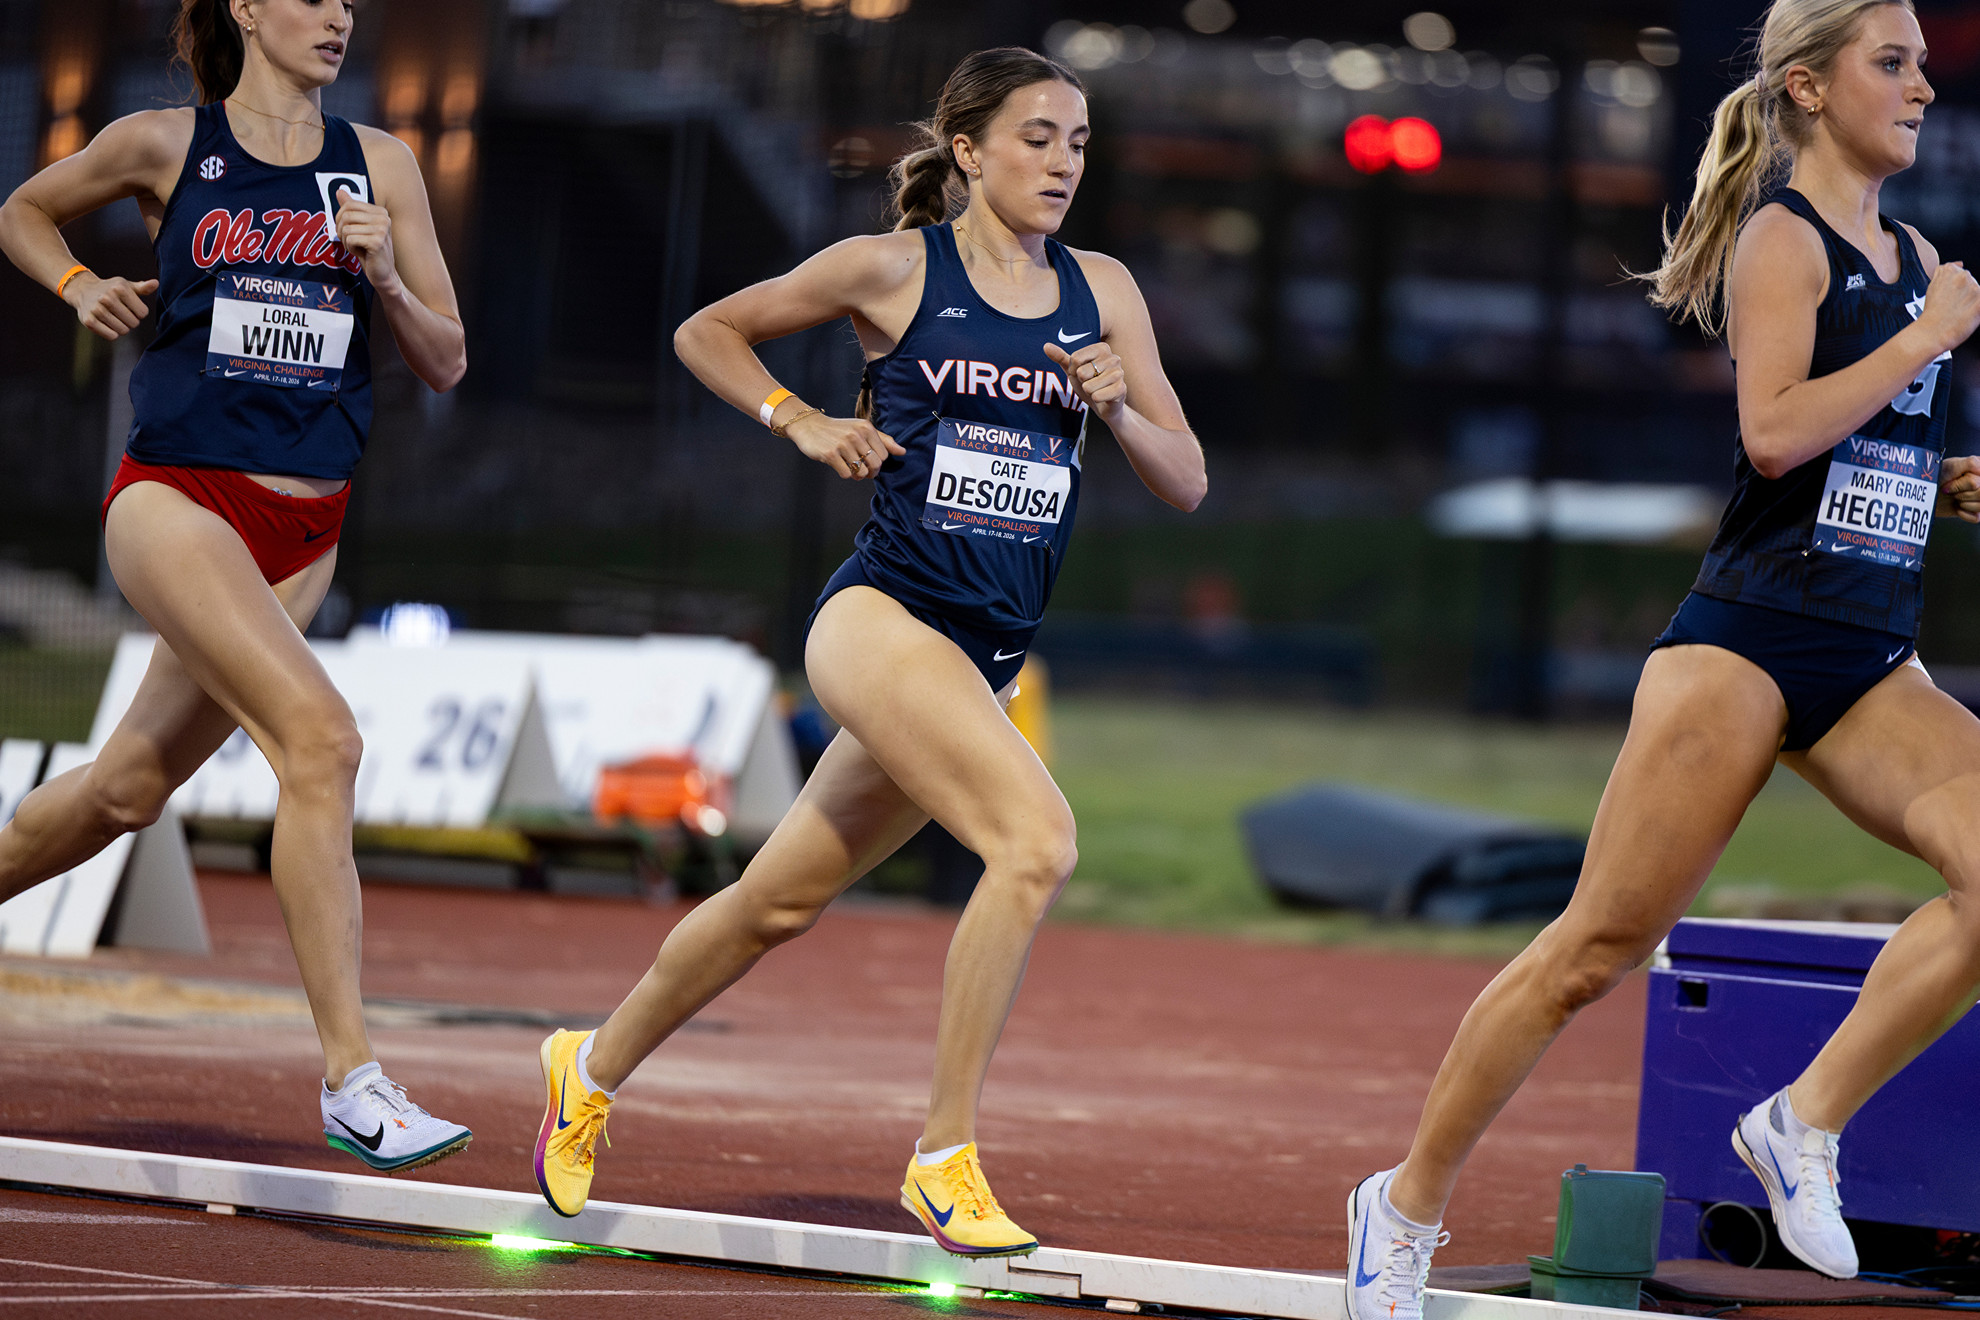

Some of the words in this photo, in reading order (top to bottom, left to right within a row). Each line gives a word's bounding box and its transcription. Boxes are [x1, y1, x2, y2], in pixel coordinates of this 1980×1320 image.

[199, 155, 226, 180] SEC
[192, 208, 265, 269] Ole
[232, 275, 305, 298] VIRGINIA
[232, 290, 265, 301] TRACK
[279, 297, 303, 306] FIELD
[262, 308, 309, 328] LORAL
[939, 307, 968, 317] ACC
[241, 324, 325, 364] WINN
[228, 358, 272, 373] VIRGINIA
[273, 364, 325, 378] CHALLENGE
[253, 373, 271, 382] APRIL
[954, 422, 1032, 450] VIRGINIA
[954, 438, 988, 451] TRACK
[992, 445, 999, 453] &
[1003, 447, 1030, 458] FIELD
[1849, 436, 1917, 467] VIRGINIA
[990, 460, 1029, 481] CATE
[1849, 454, 1880, 468] TRACK
[1892, 463, 1914, 475] FIELD
[935, 471, 1060, 519] DESOUSA
[1850, 471, 1893, 495] MARY
[1895, 480, 1928, 503] GRACE
[947, 510, 989, 526] VIRGINIA
[990, 520, 1041, 534] CHALLENGE
[1825, 489, 1930, 541] HEGBERG
[971, 527, 987, 536] APRIL
[1003, 532, 1016, 540] 2026
[1836, 530, 1879, 549] VIRGINIA
[1860, 548, 1877, 559] APRIL
[414, 697, 505, 775] 26
